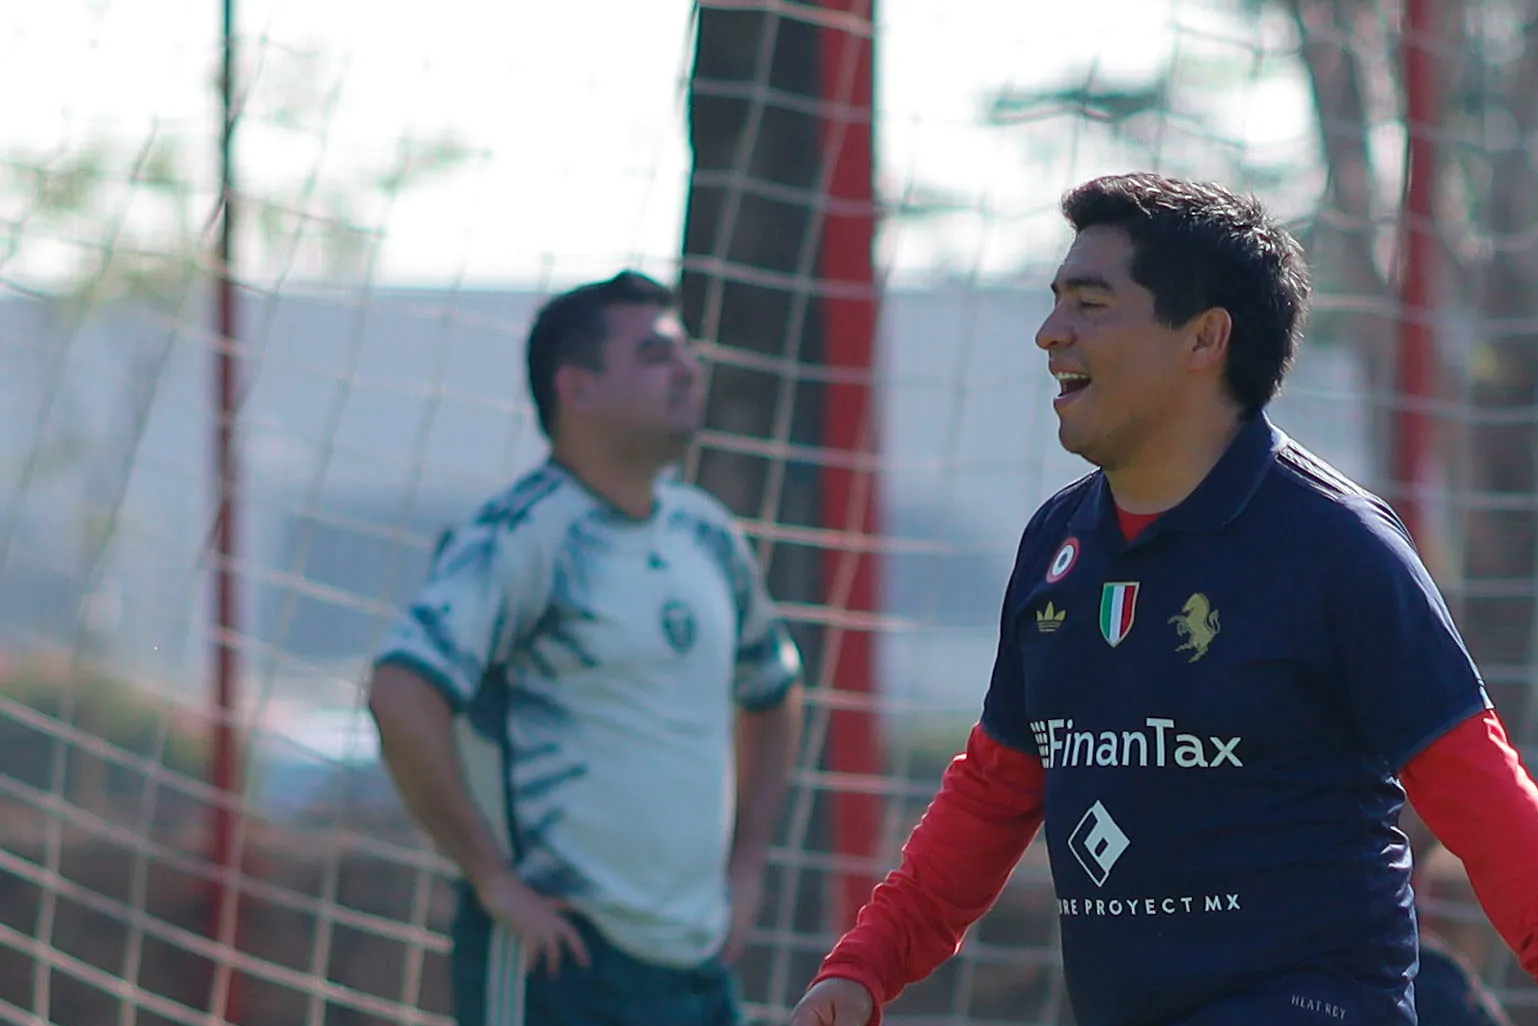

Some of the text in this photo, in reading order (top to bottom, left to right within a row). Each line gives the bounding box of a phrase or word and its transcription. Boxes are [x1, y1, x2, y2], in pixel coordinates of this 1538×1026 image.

[1048, 717, 1243, 768] FinanTax
[1085, 897, 1193, 916] PROYECT
[1204, 894, 1241, 912] MX
